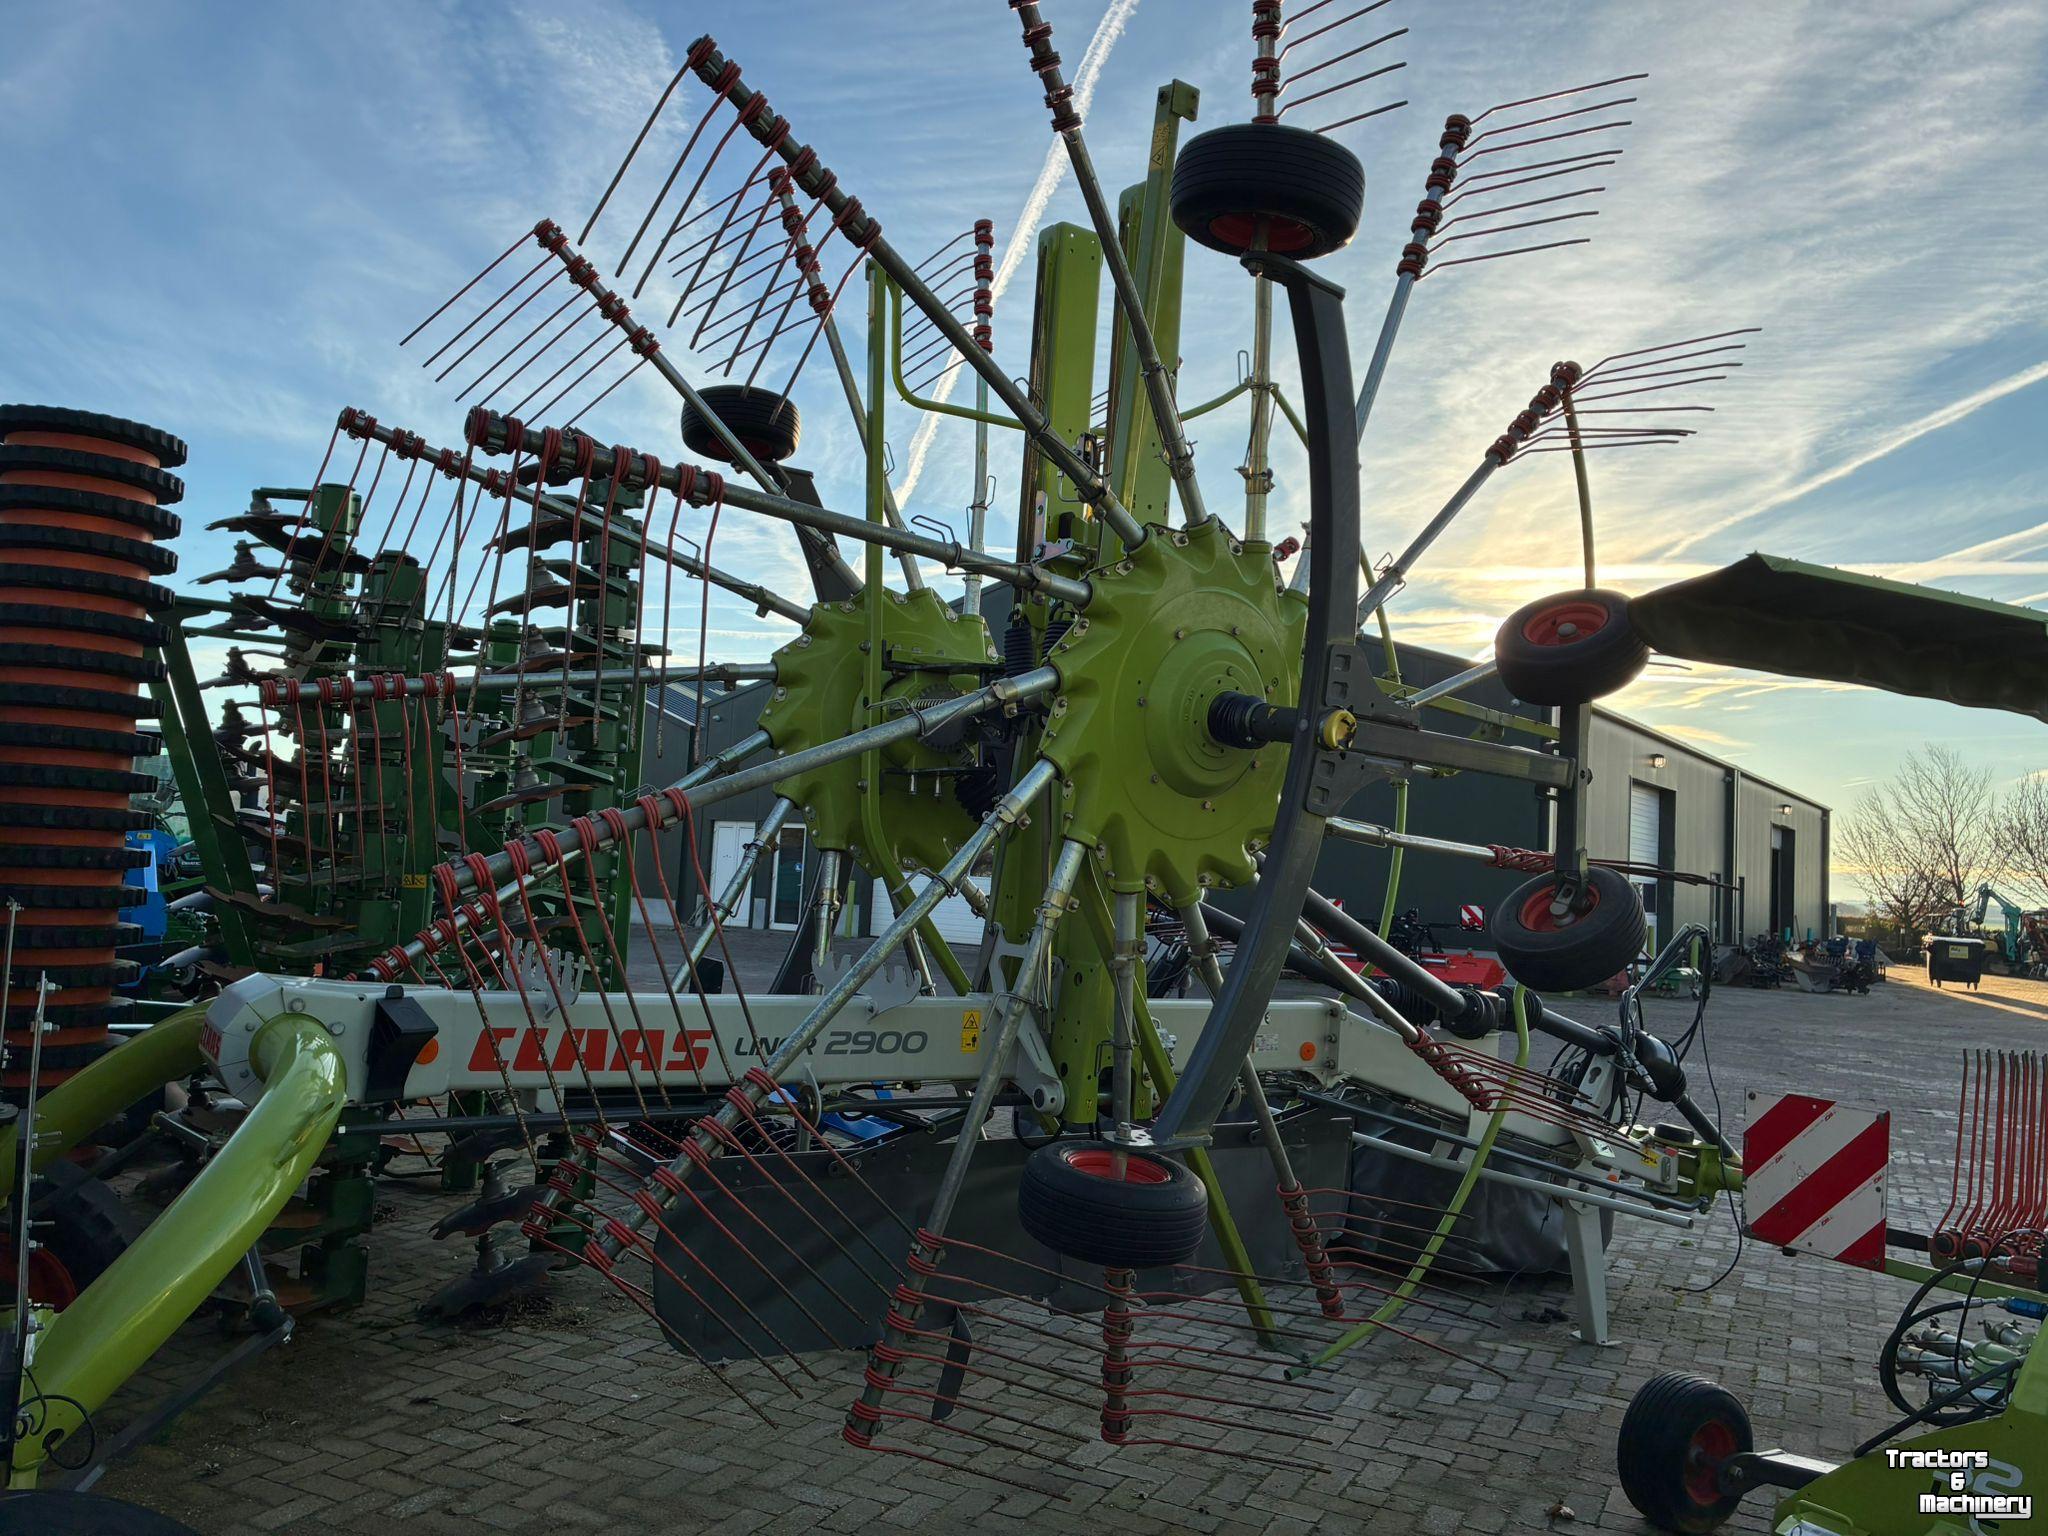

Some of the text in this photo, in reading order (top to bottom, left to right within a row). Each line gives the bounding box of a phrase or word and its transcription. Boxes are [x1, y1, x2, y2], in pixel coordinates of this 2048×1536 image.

[468, 1028, 713, 1071] CLAAS
[734, 1031, 928, 1056] LINR 2900
